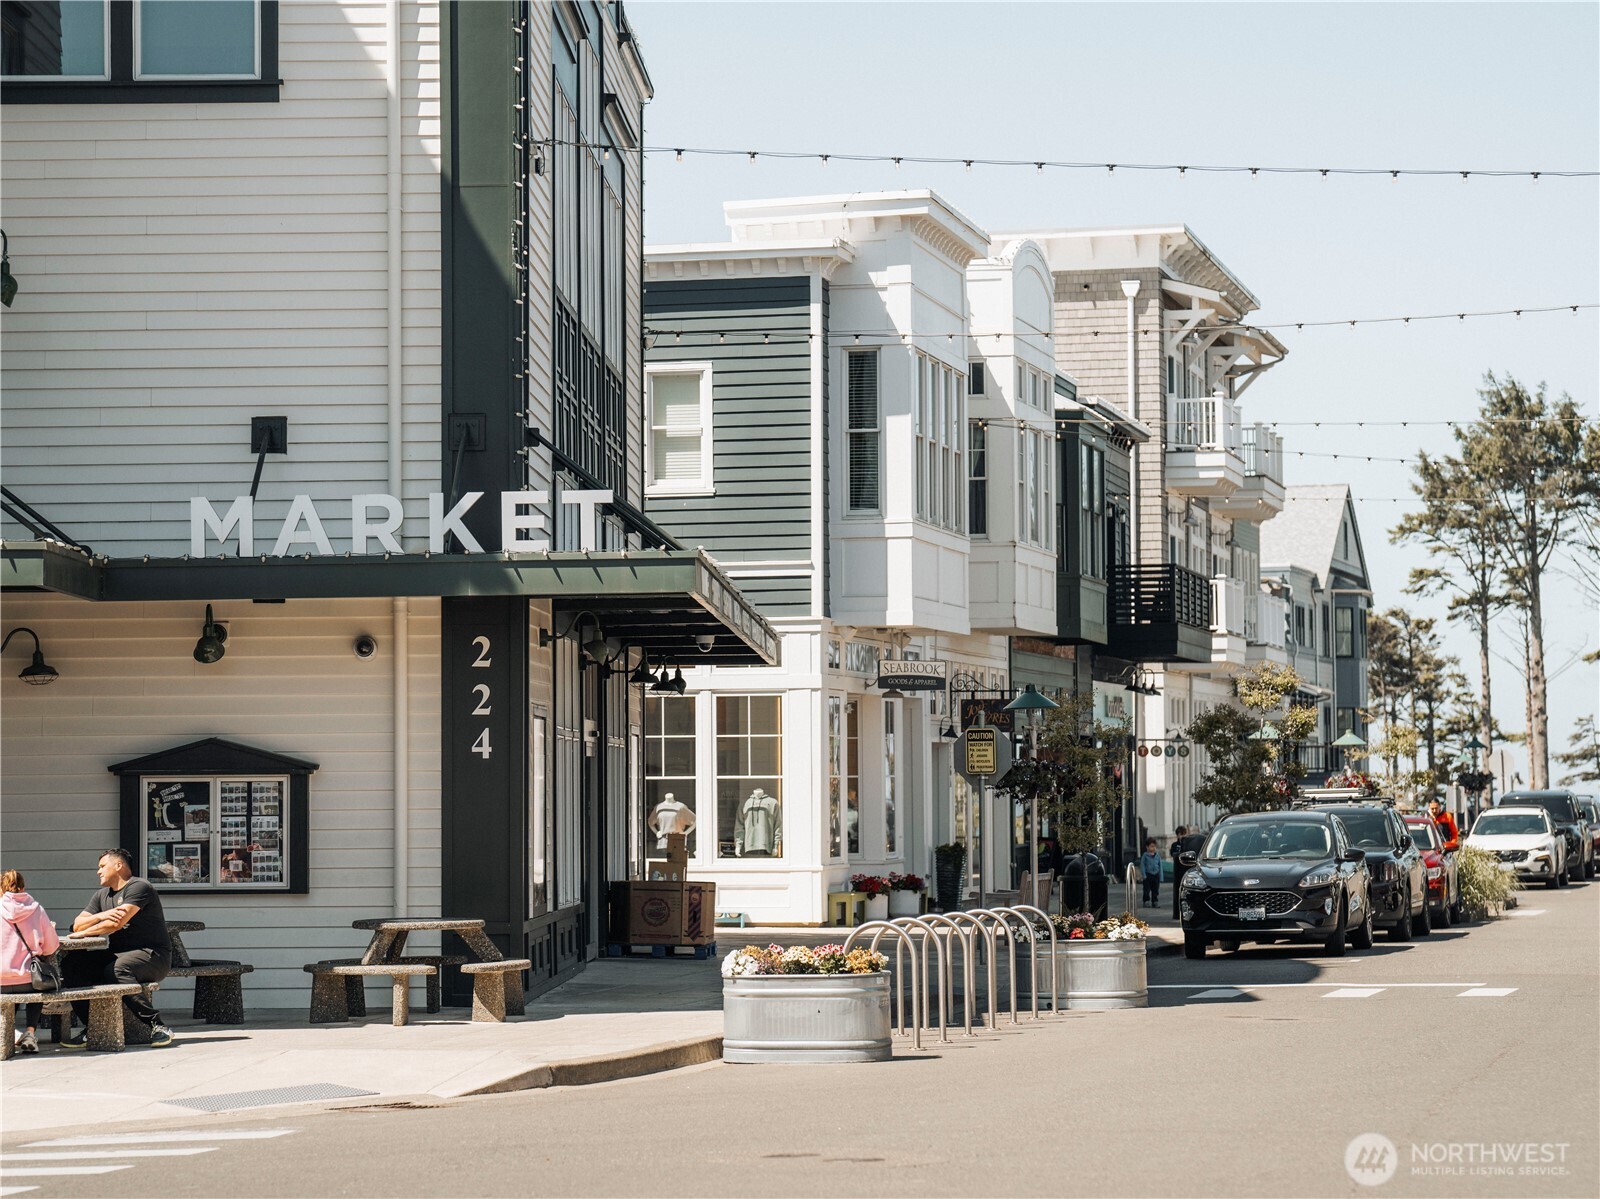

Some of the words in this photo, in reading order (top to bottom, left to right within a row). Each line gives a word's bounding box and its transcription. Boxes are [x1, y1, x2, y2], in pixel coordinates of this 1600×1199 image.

[190, 489, 614, 557] MARKET
[883, 662, 941, 676] SEABROOK
[908, 678, 914, 686] &
[470, 635, 493, 760] 224
[967, 732, 994, 740] CAUTION
[1139, 747, 1188, 757] TOYS
